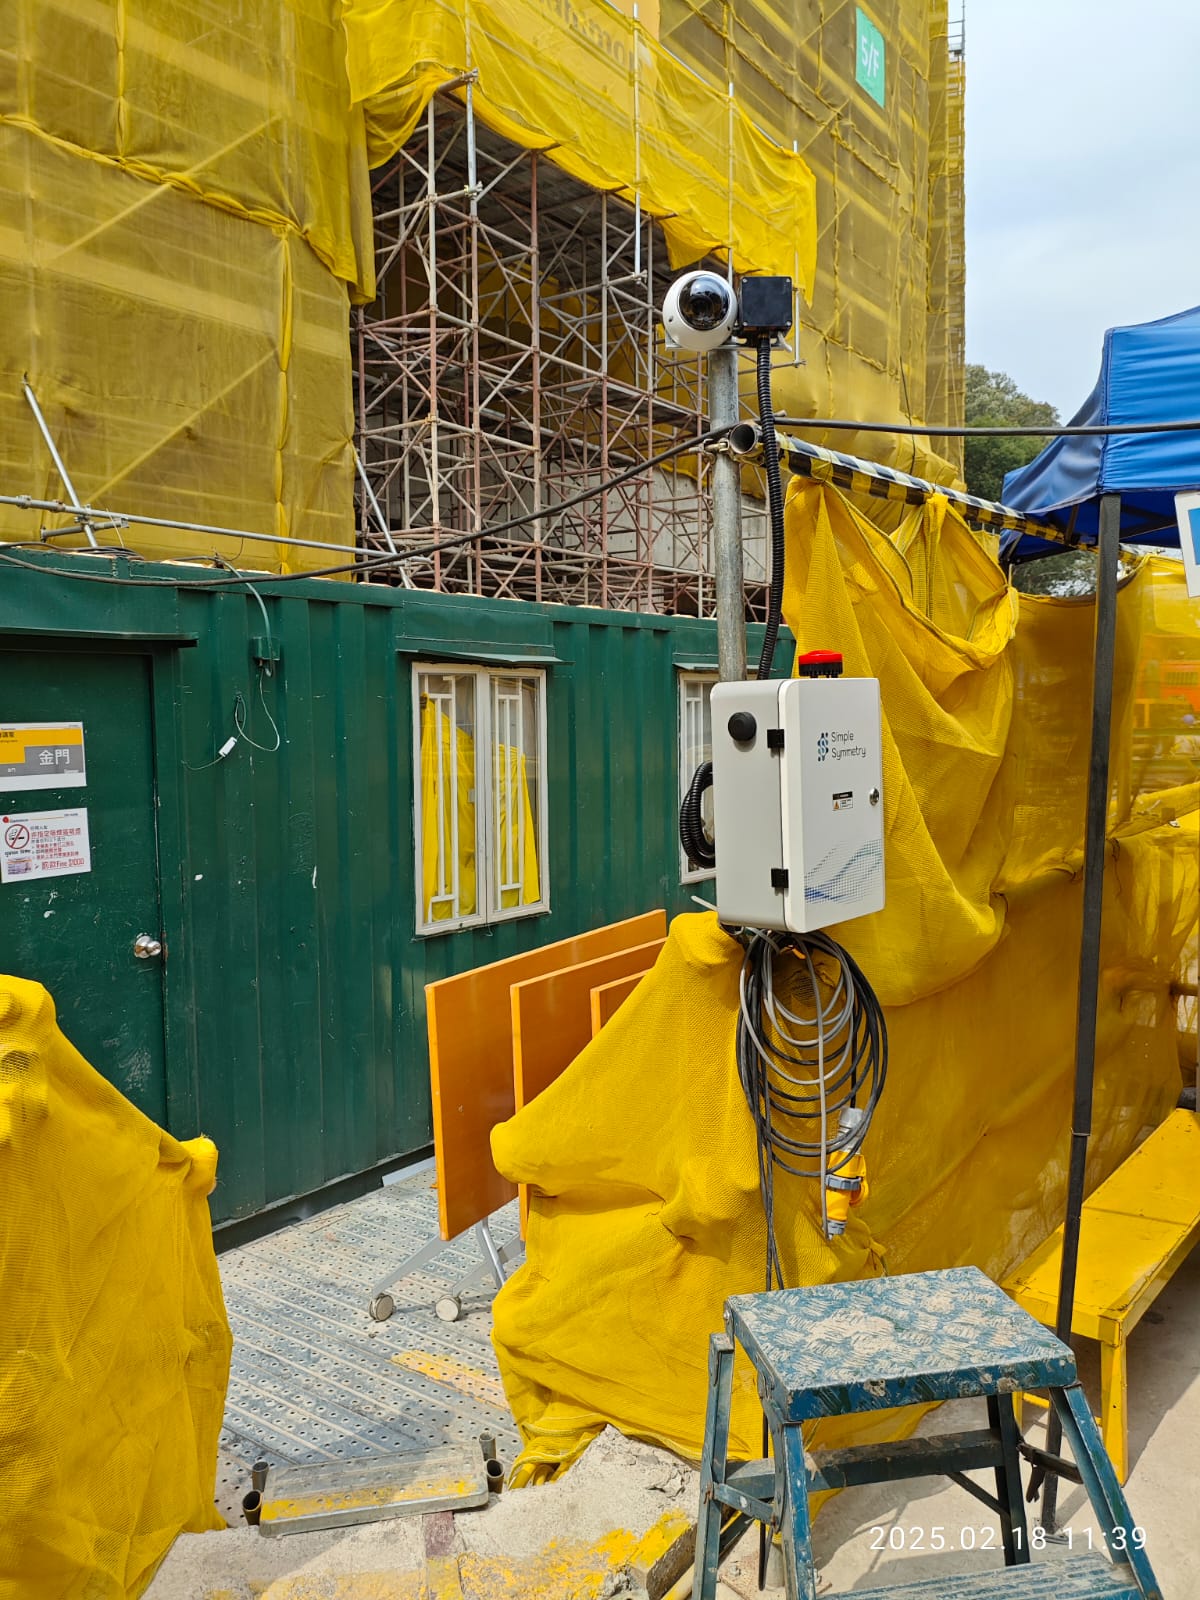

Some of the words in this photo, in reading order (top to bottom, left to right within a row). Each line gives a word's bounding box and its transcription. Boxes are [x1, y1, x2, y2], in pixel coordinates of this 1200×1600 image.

[861, 34, 879, 78] 5/F
[831, 730, 854, 744] Simple
[39, 748, 70, 766] 金門
[831, 745, 866, 760] Symmetry
